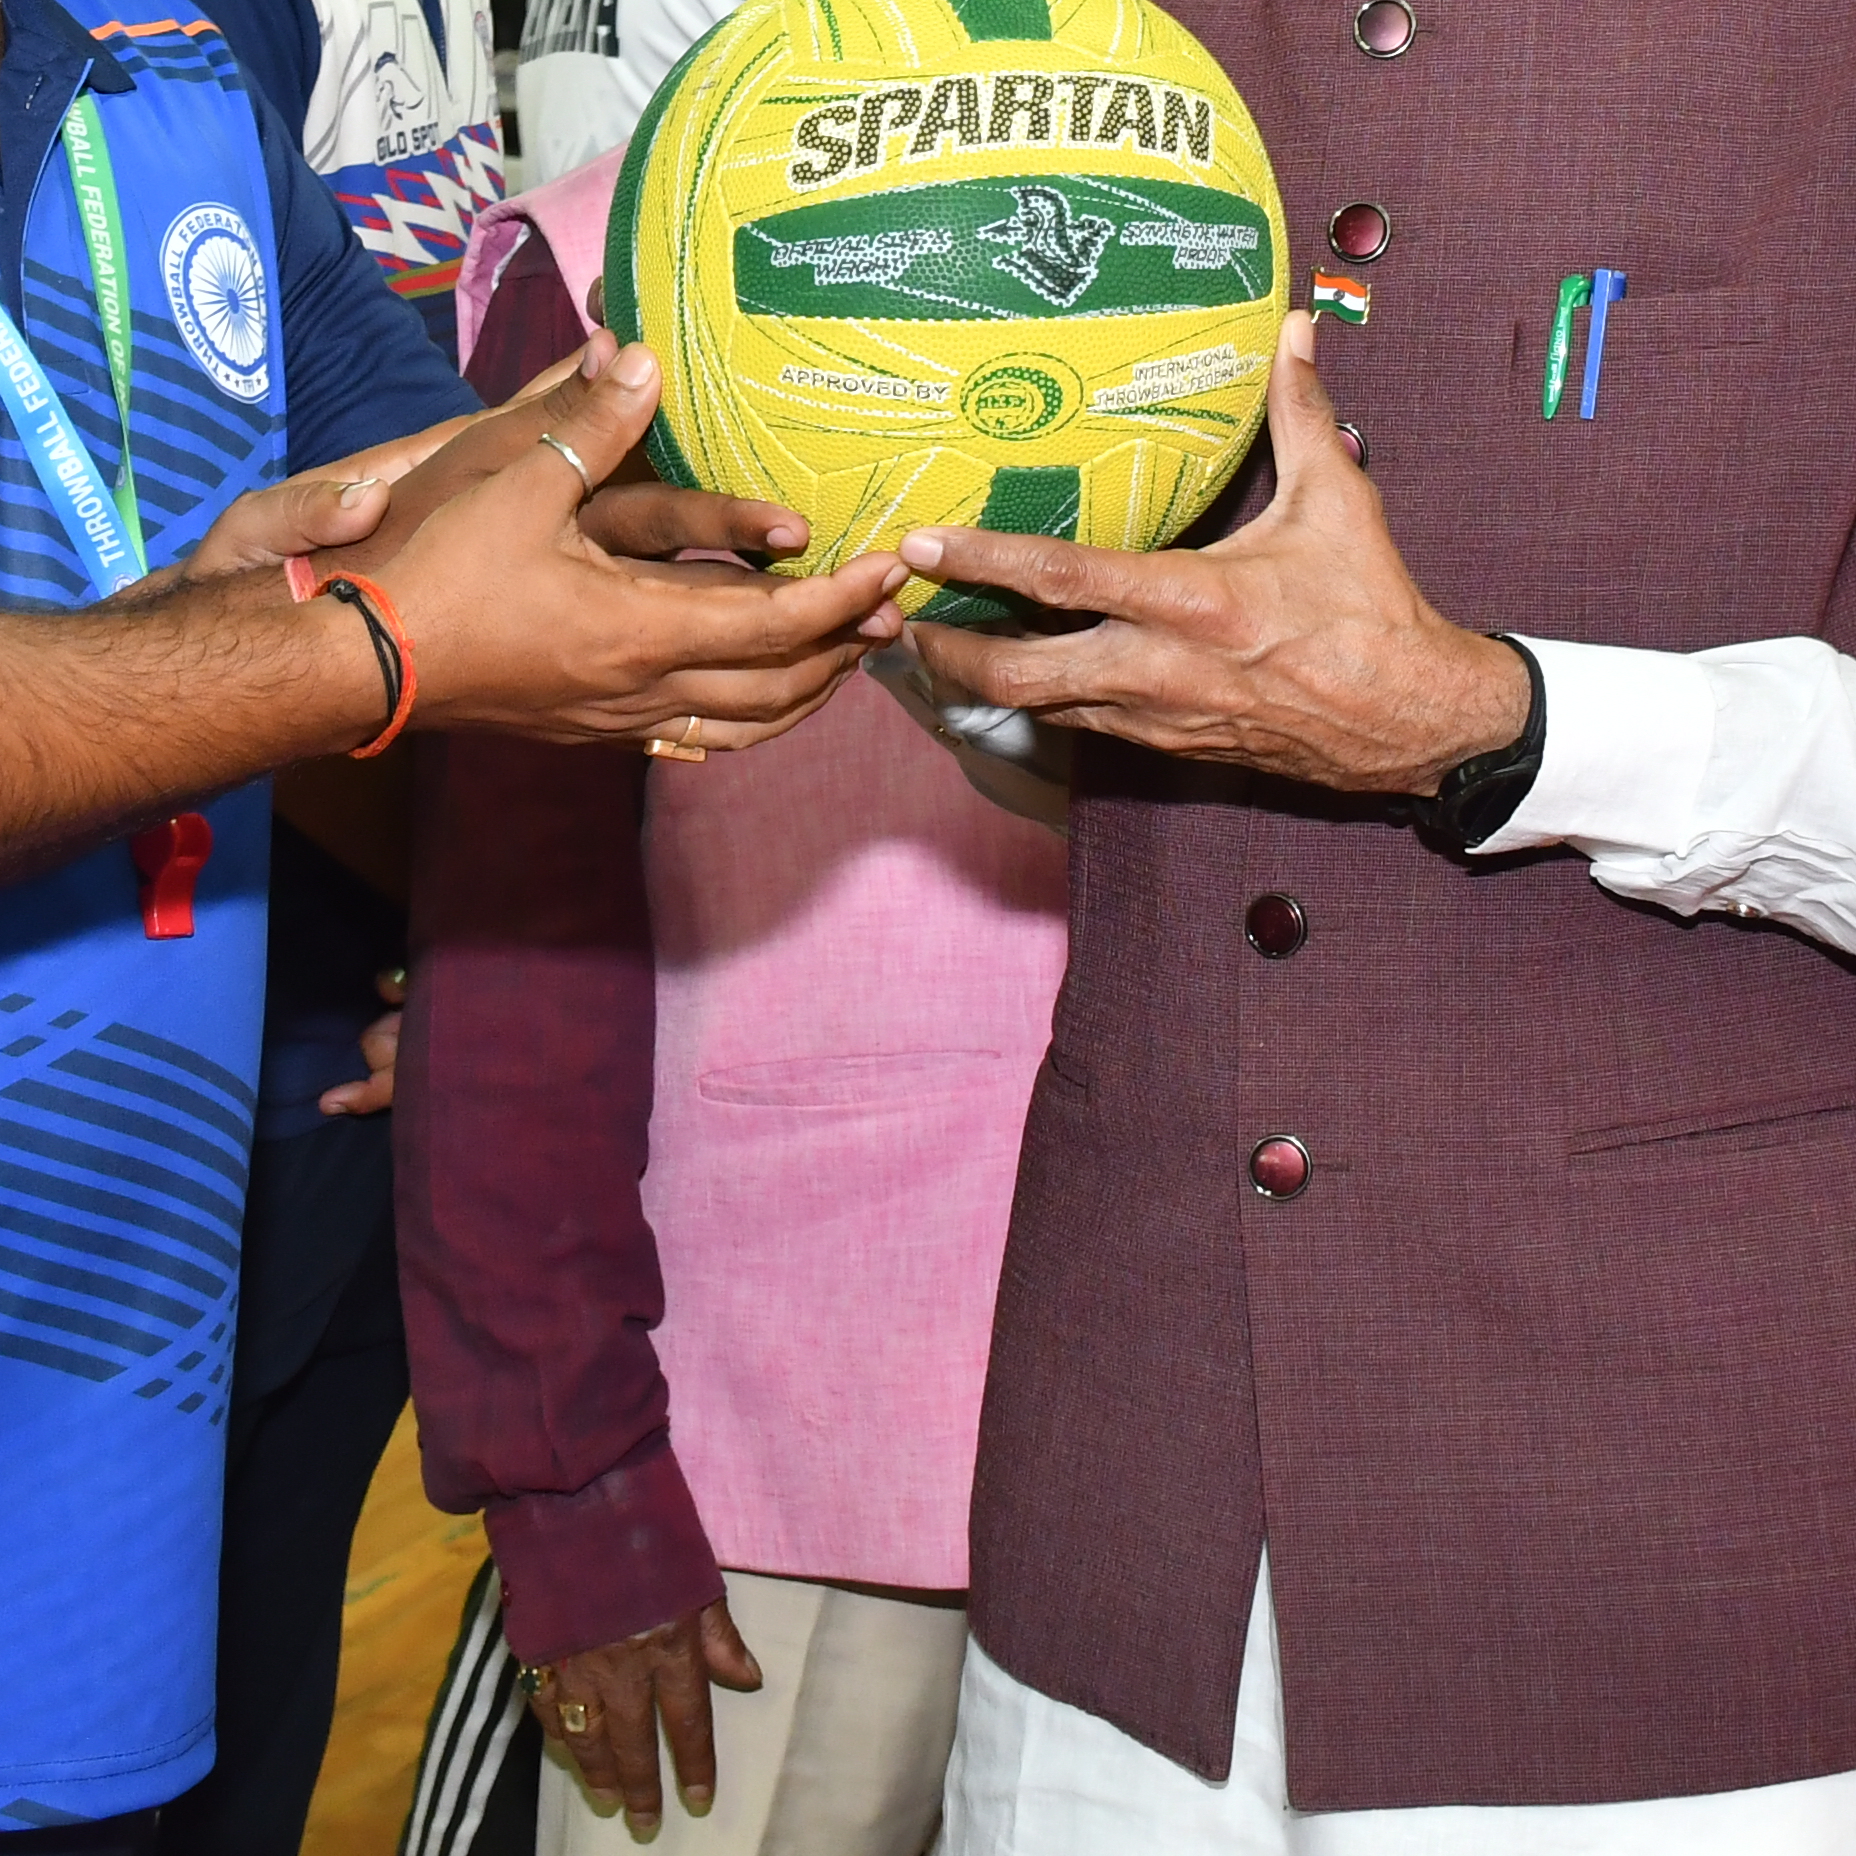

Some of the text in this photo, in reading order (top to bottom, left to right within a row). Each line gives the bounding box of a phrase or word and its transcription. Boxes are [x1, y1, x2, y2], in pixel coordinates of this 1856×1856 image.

[790, 74, 1213, 186] SPARTAN
[80, 184, 122, 335] FEDERATION
[110, 339, 126, 375] OF
[169, 249, 220, 377] THROWBALL
[781, 368, 950, 401] APPROVED BY
[1095, 383, 1185, 406] THROWBALL
[1135, 347, 1234, 381] INTERNATIONAL
[35, 410, 126, 569] THROWBALL
